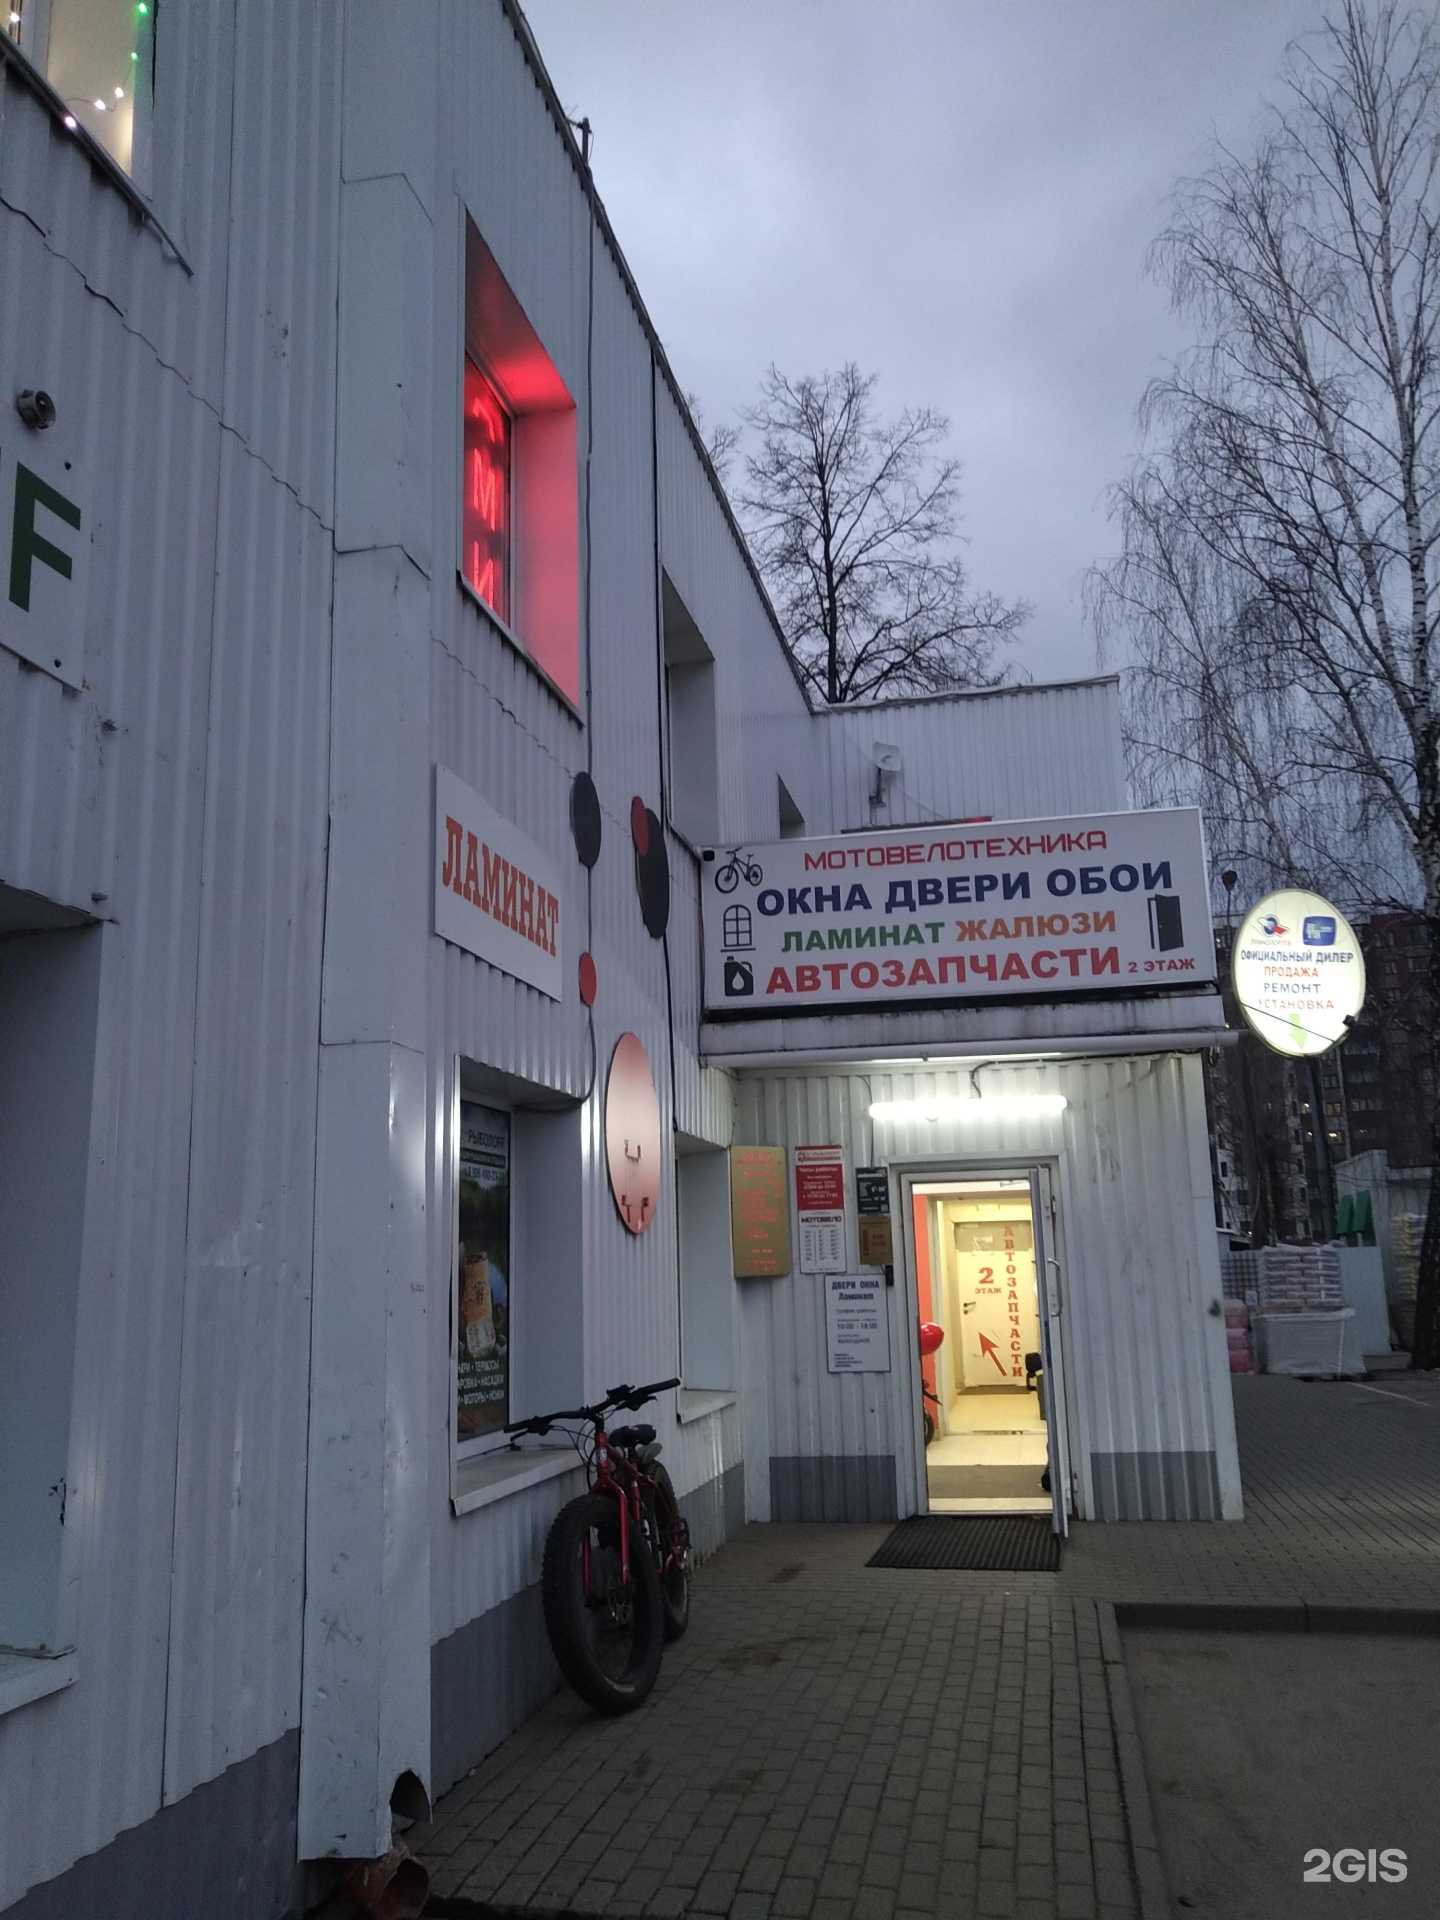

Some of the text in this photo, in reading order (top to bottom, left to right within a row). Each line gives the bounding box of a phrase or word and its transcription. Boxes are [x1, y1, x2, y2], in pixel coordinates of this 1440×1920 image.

[804, 830, 1107, 871] МОТОВЕЛОТЕХНИКА
[442, 815, 559, 957] ЛАМИНАТ
[757, 861, 1173, 917] ОКНА ДВЕРИ ОБОИ
[781, 910, 1117, 953] ЛАМИНАТ ЖАЛЮЗИ
[765, 946, 1196, 996] АВТОЗАПЧАСТИ 2 ЭТАЖ
[1241, 949, 1354, 964] ОФИЦИАЛЬНЫЙ ДИЛЕР
[1263, 966, 1319, 978] ПРОДАЖА
[1263, 982, 1321, 994] РЕМОНТ
[832, 1280, 880, 1290] ДВЕРИ ОКНА
[979, 1267, 994, 1285] 2
[975, 1287, 1002, 1295] ЭТАЖ
[1003, 1224, 1023, 1377] АВТОЗАПЧАСТИ
